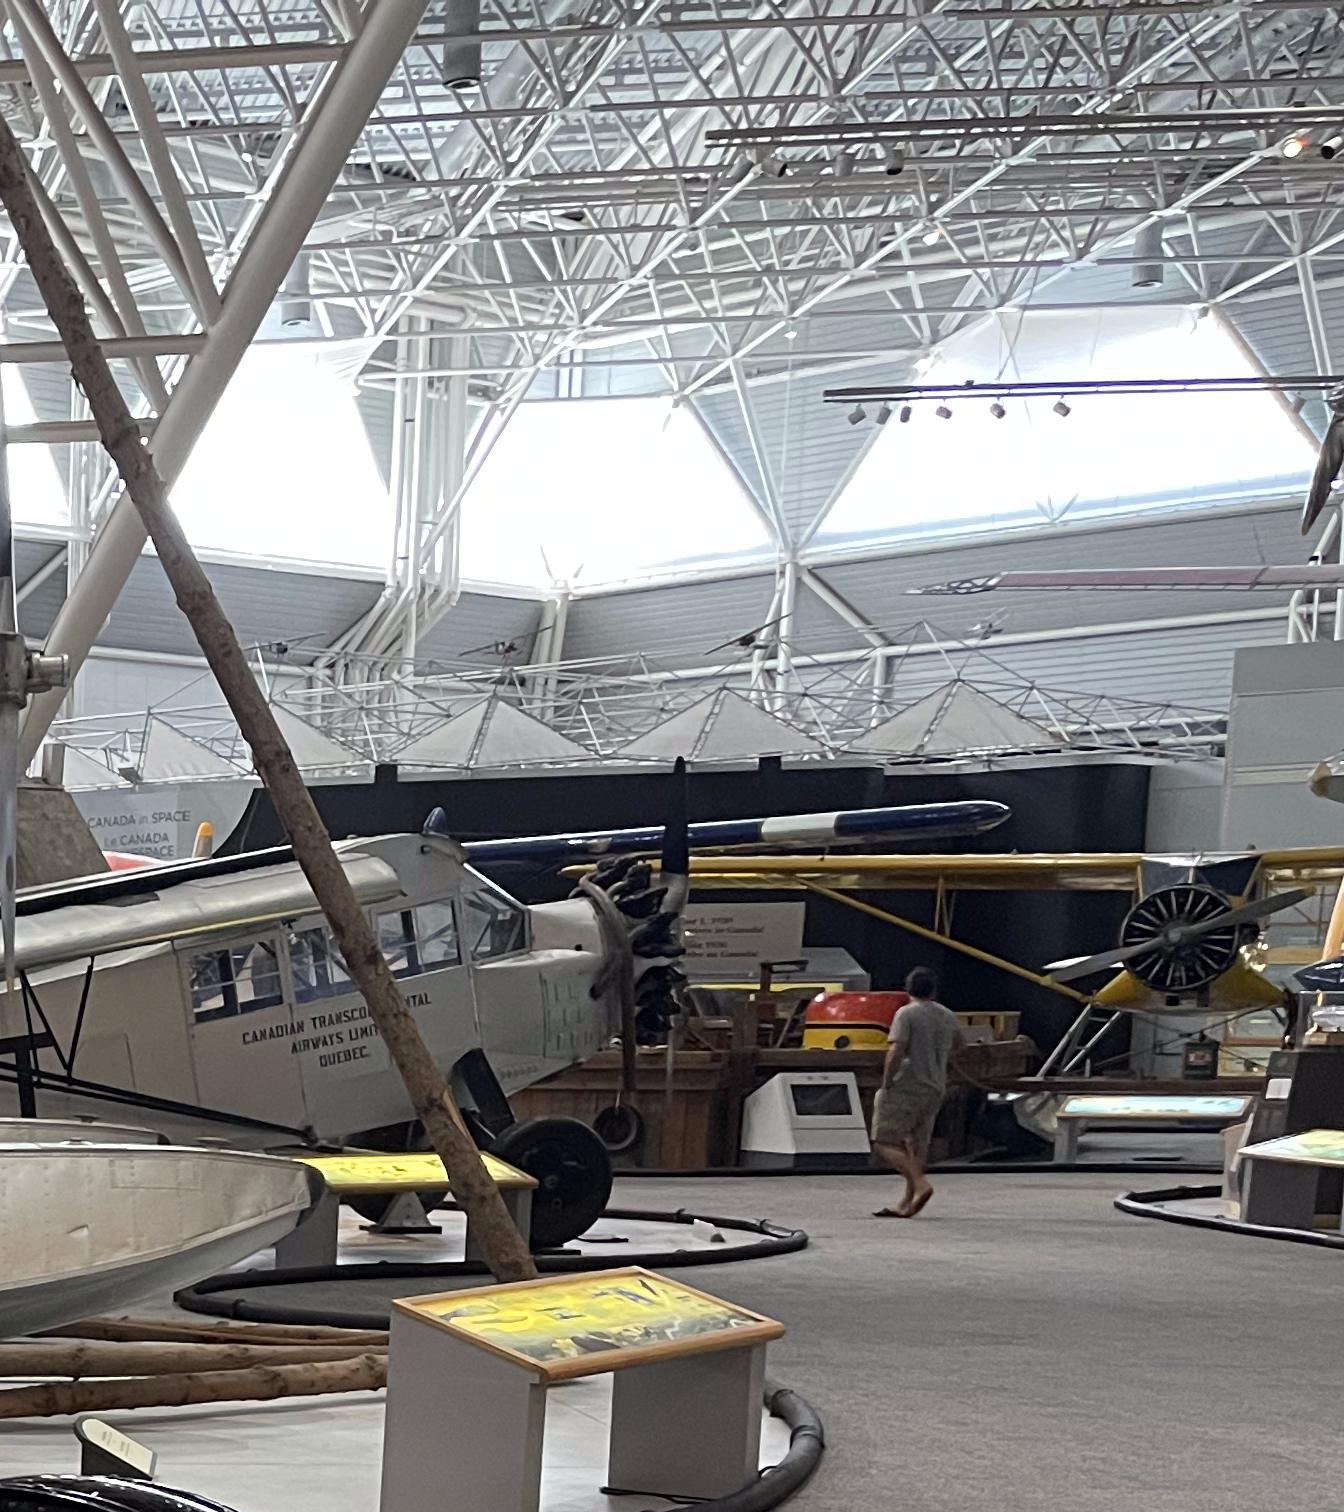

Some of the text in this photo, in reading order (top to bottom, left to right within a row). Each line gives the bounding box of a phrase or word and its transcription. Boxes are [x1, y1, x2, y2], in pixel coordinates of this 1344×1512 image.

[88, 813, 137, 828] CANADA
[151, 810, 191, 824] SPACE
[120, 832, 170, 846] CANADA
[242, 1020, 305, 1046] CANADIAN
[291, 1032, 344, 1055] AIRWAYS
